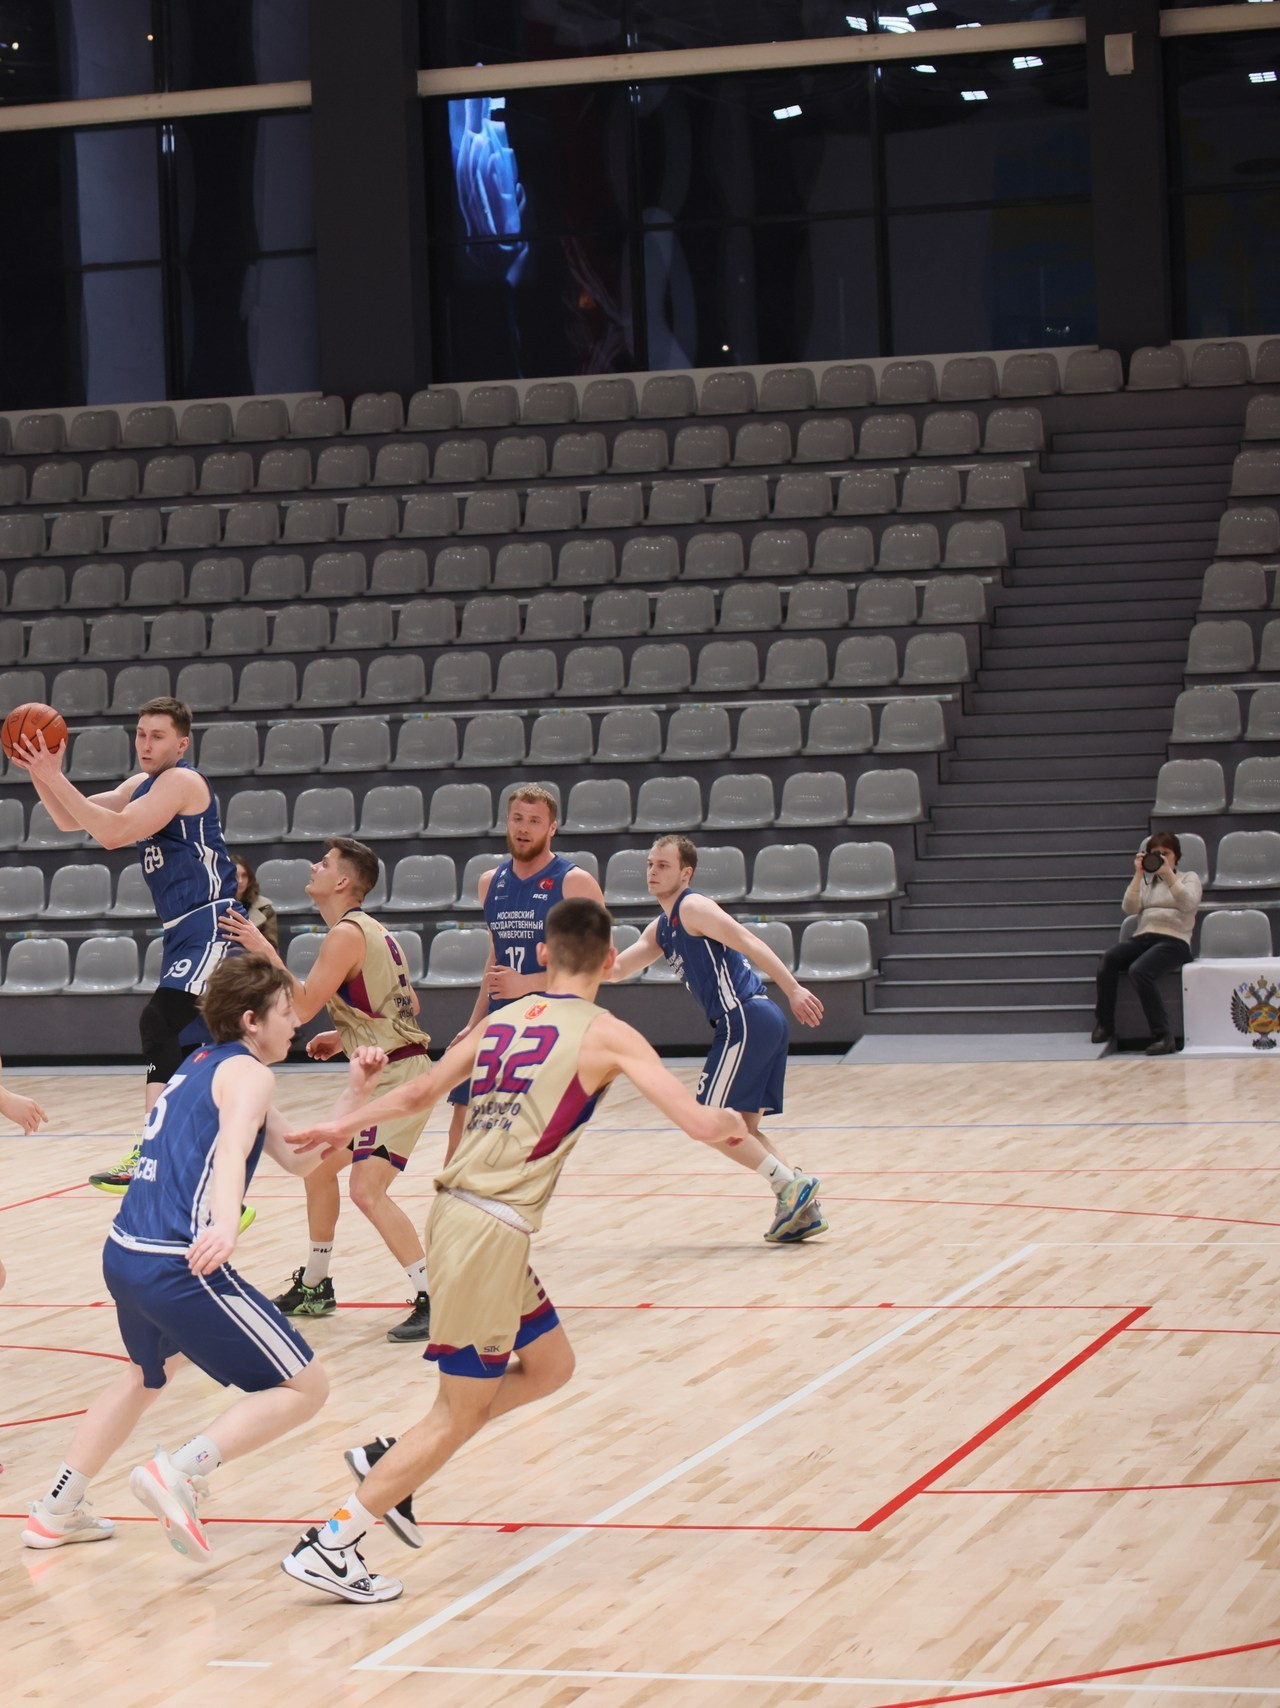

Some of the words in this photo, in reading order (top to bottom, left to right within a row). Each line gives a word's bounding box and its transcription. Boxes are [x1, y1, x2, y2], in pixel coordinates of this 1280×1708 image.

[144, 845, 164, 874] 69
[497, 909, 535, 920] МОСКОВСКИЙ
[490, 919, 544, 931] ГОСУДАРСТВЕННЫЙ
[497, 930, 535, 939] УНИВЕРСИТЕТ
[505, 946, 525, 974] 17
[471, 1023, 560, 1098] 32
[483, 1345, 500, 1353] STK
